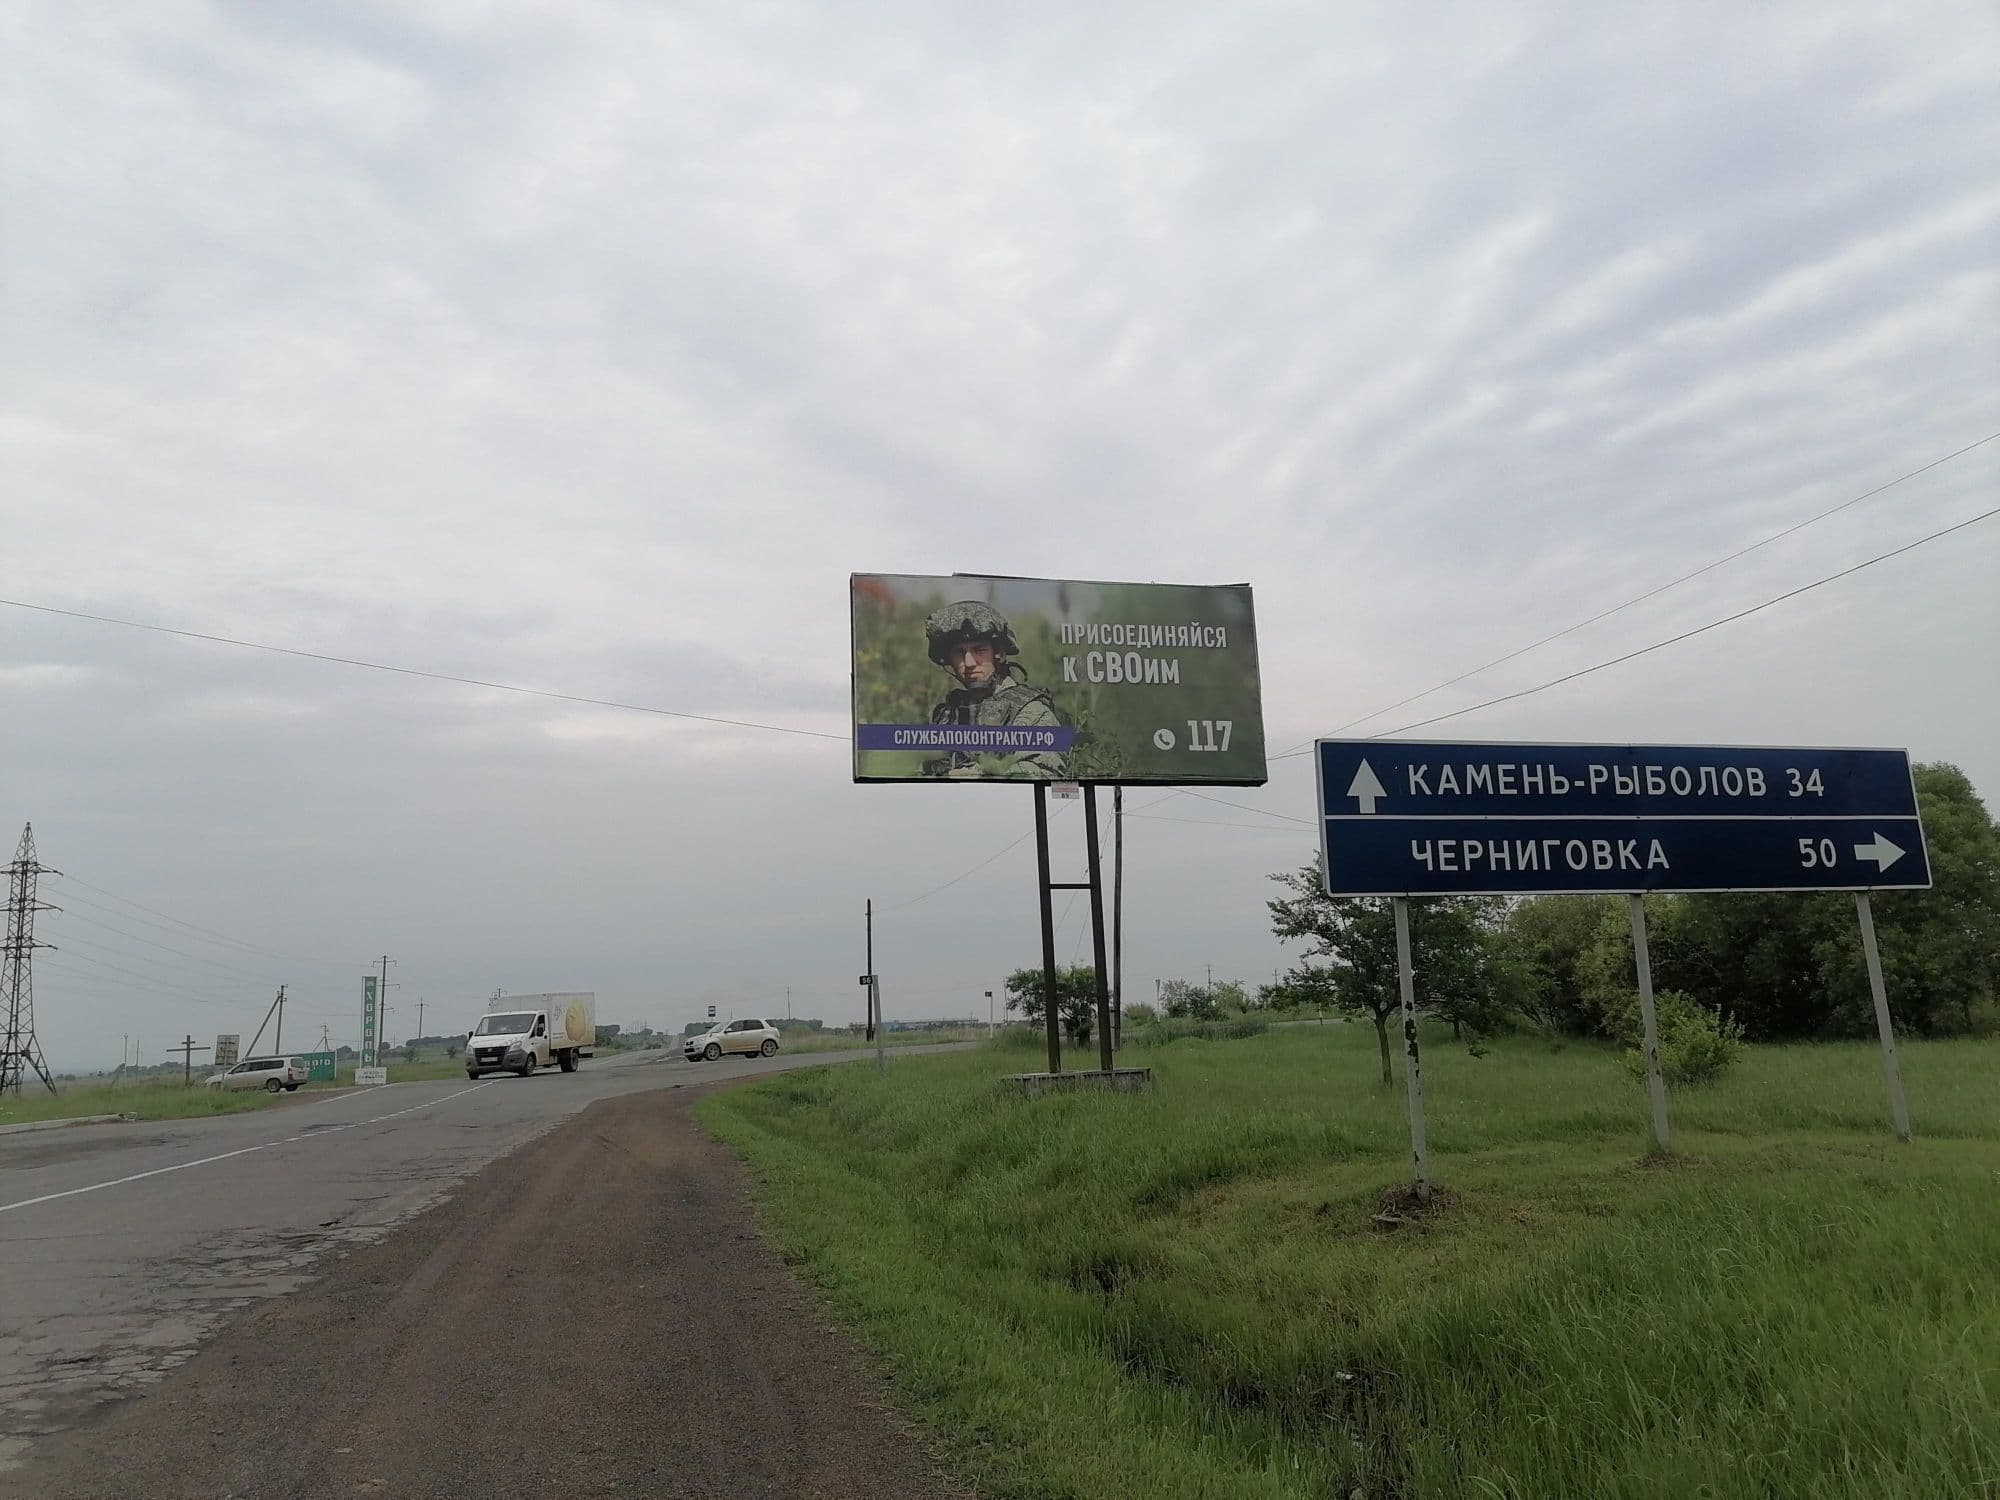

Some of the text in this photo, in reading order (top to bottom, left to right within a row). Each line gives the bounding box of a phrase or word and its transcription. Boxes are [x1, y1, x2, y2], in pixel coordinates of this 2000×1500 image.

[1061, 622, 1227, 648] ПРИСОЕДИНЯЙСЯ
[894, 730, 1054, 746] СЛУЖБАПОКОНТРАКТУ.РФ
[1187, 720, 1232, 751] 117
[1408, 764, 1824, 797] КАМЕНЬ-РЫБОЛОВ 34
[1412, 838, 1837, 871] ЧЕРНИГОВКА 50
